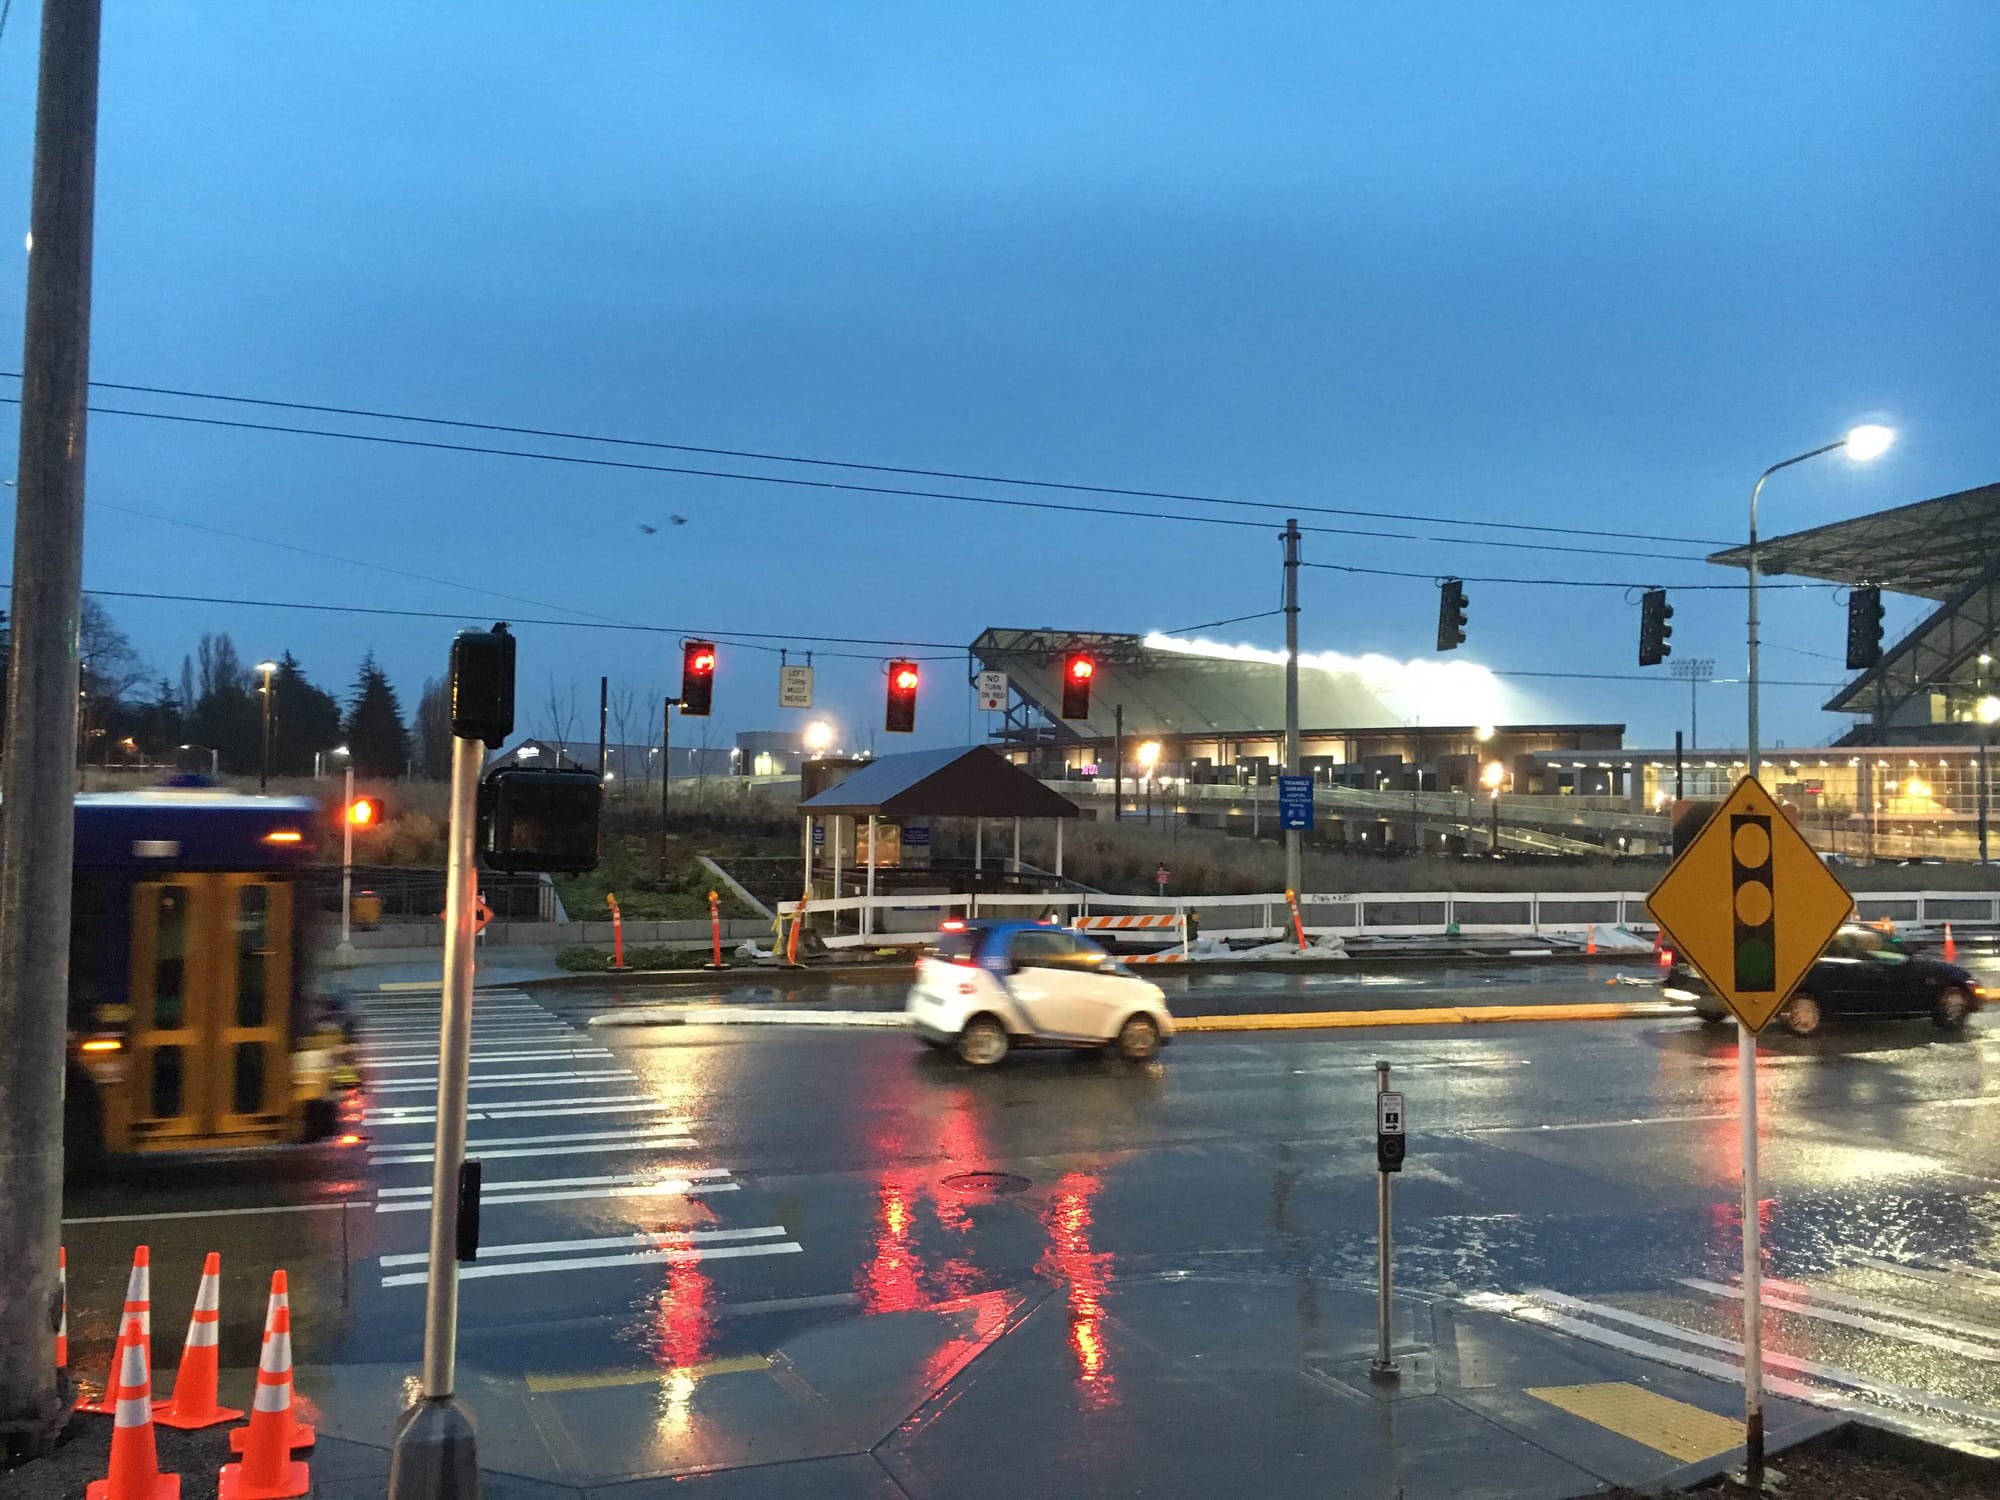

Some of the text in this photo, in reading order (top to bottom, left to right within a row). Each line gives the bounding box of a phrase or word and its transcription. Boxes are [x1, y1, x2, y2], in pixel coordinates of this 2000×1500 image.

[788, 669, 805, 677] LEFT
[788, 678, 806, 686] TURN
[987, 674, 999, 683] NO
[784, 695, 808, 703] MERGE
